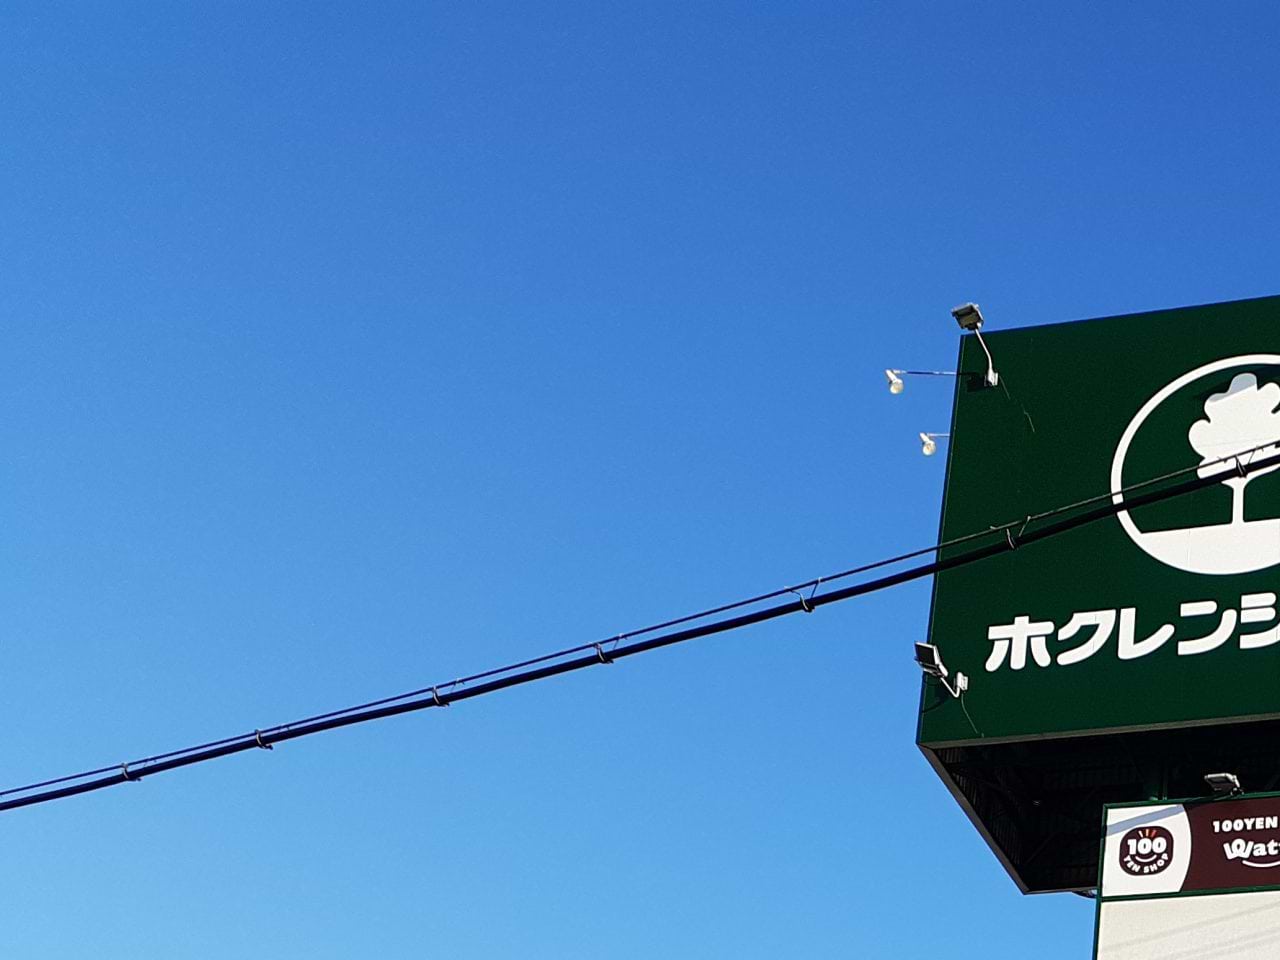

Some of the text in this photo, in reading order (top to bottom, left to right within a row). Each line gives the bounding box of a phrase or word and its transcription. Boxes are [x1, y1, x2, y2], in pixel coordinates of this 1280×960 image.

[1212, 814, 1278, 833] 100YEN
[1127, 836, 1168, 855] 100
[1123, 853, 1169, 874] YEN SHOP
